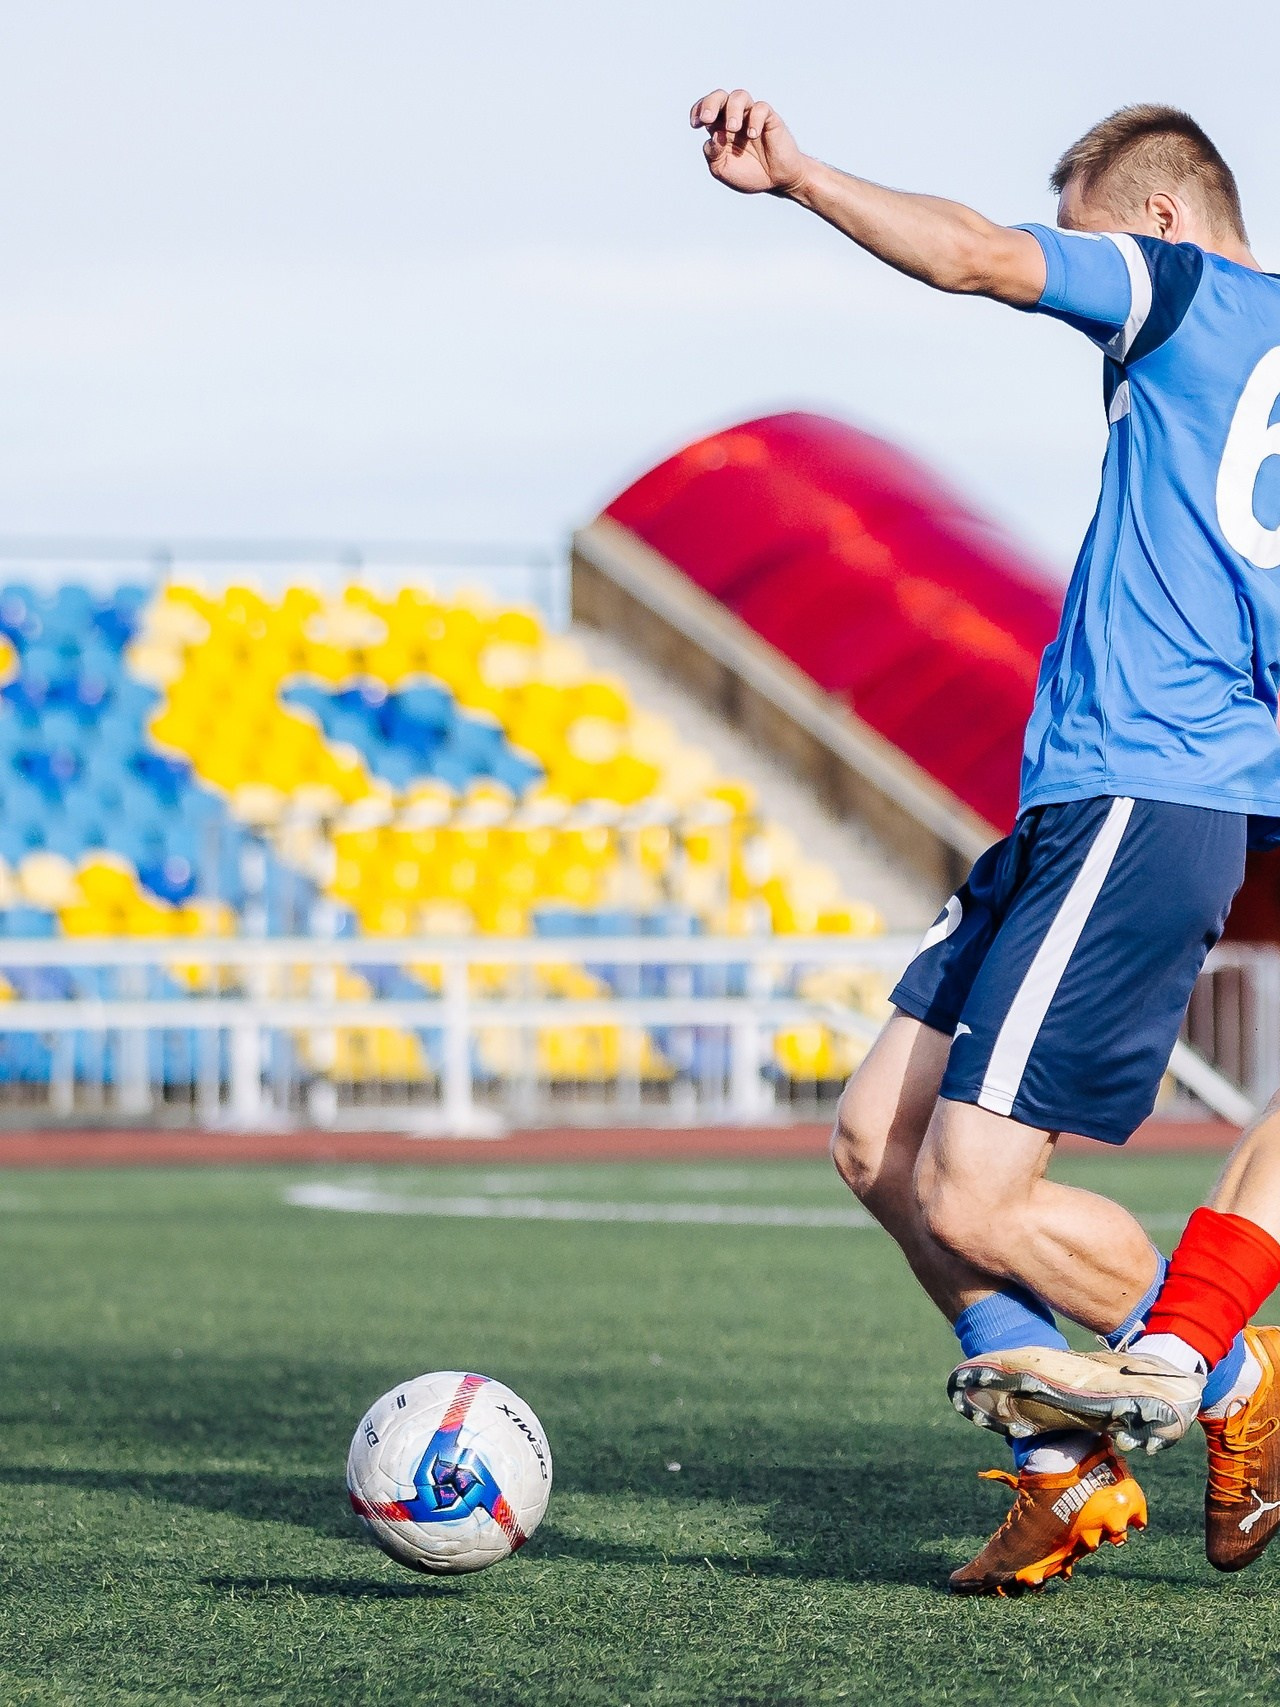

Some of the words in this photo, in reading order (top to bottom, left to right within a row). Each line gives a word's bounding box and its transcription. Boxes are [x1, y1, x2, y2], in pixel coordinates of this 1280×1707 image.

[363, 1415, 380, 1448] DE
[495, 1403, 548, 1480] DEMIX
[1051, 1463, 1117, 1525] PUMA
